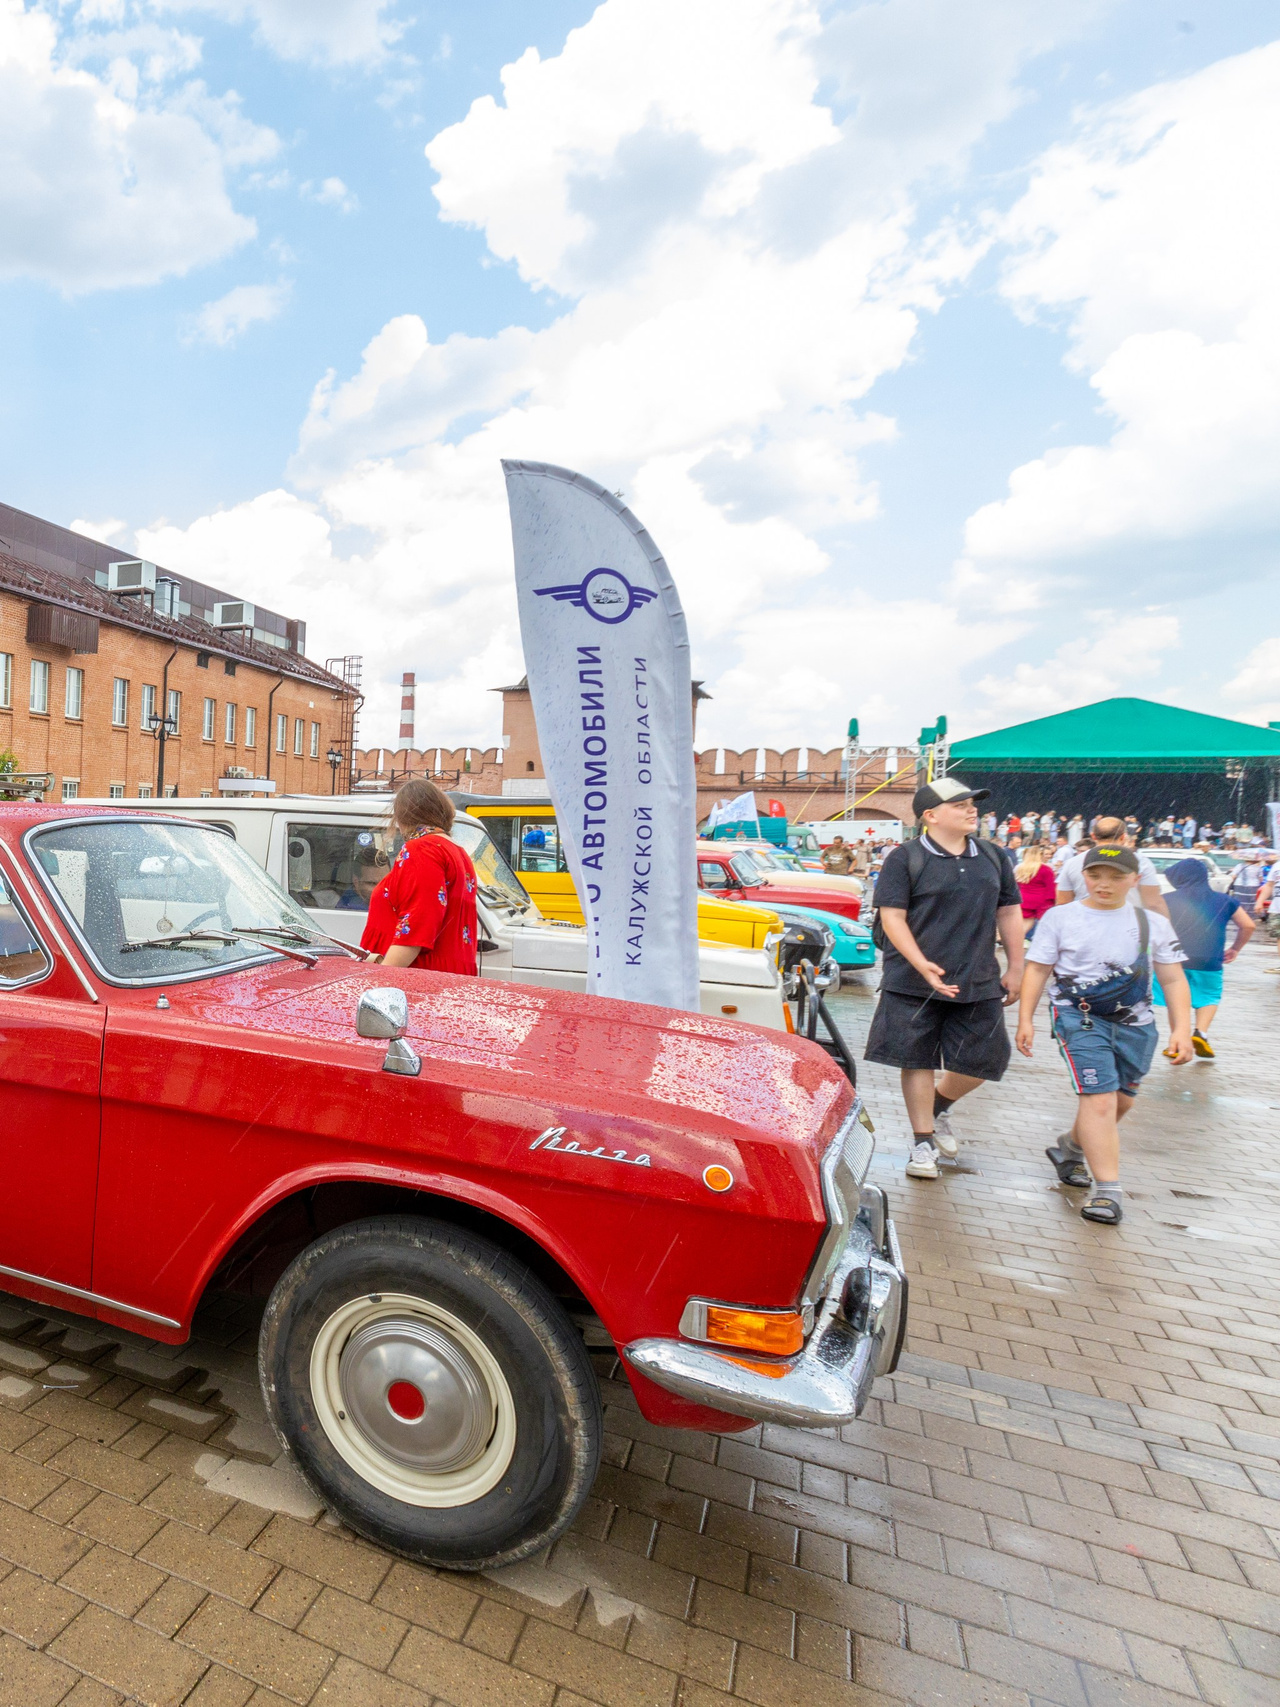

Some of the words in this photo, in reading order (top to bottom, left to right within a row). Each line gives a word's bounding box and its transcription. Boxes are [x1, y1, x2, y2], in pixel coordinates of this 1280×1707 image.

[577, 646, 607, 871] АВТОМОБИЛИ
[634, 657, 653, 785] ОБЛАСТИ
[625, 806, 653, 966] КАЛУЖСКОЙ
